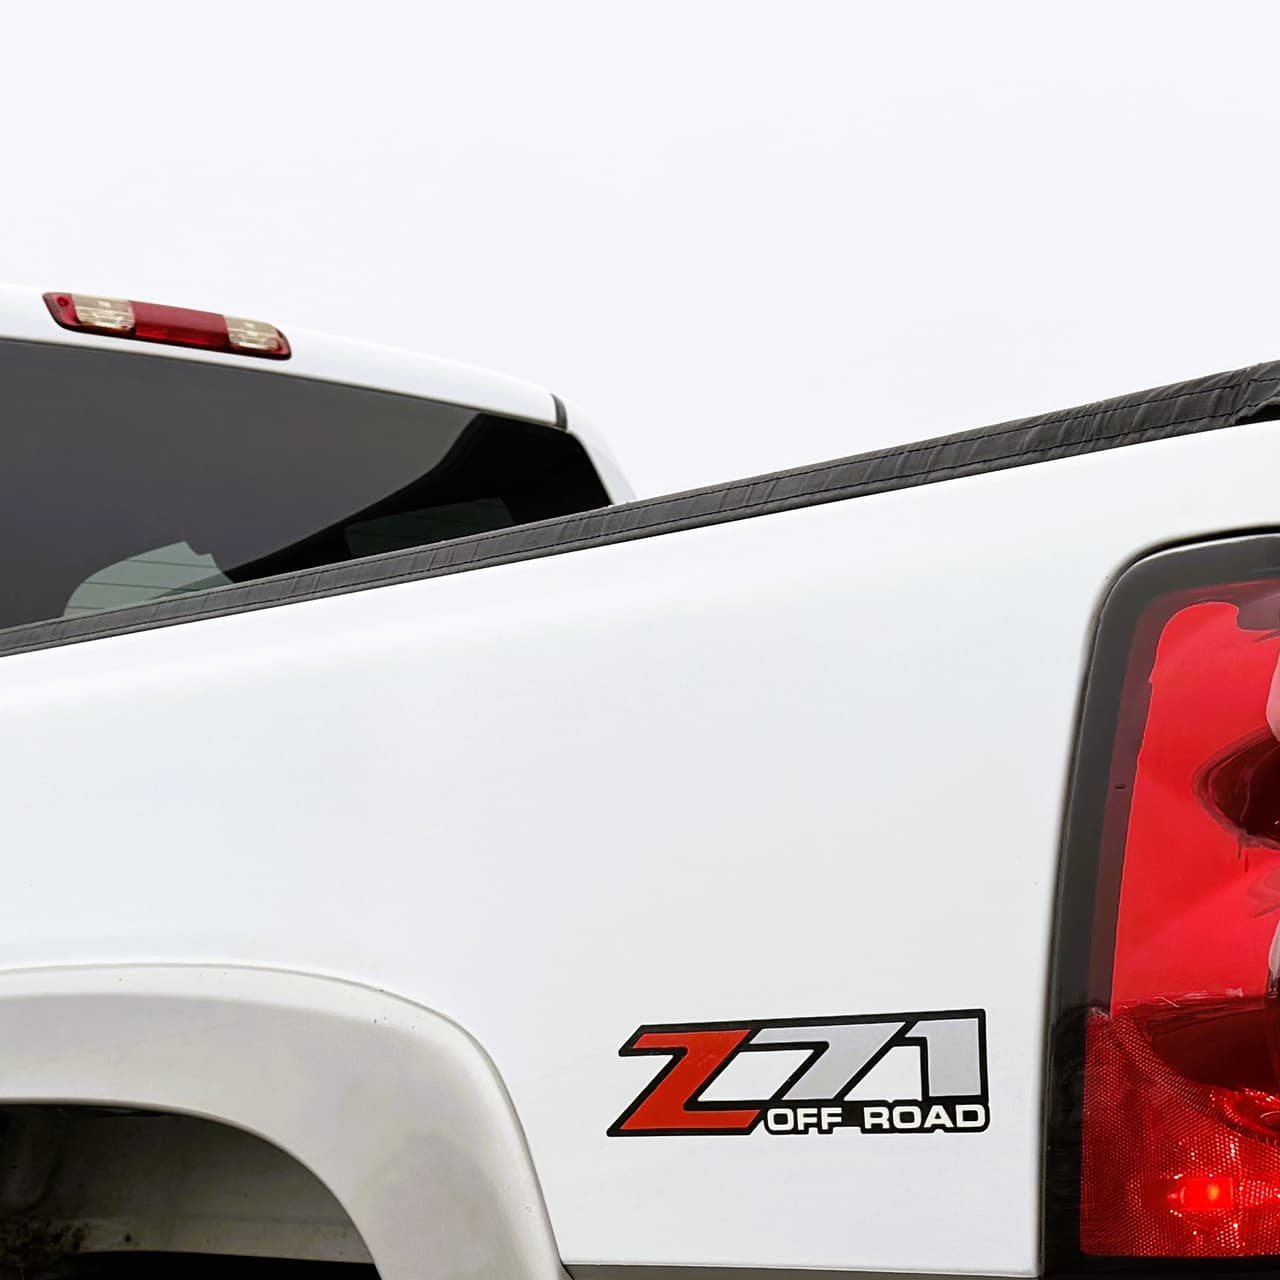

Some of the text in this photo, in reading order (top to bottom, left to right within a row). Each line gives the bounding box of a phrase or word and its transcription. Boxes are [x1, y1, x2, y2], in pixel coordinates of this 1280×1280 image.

[608, 1009, 988, 1136] Z71
[767, 1102, 987, 1132] OFF ROAD
